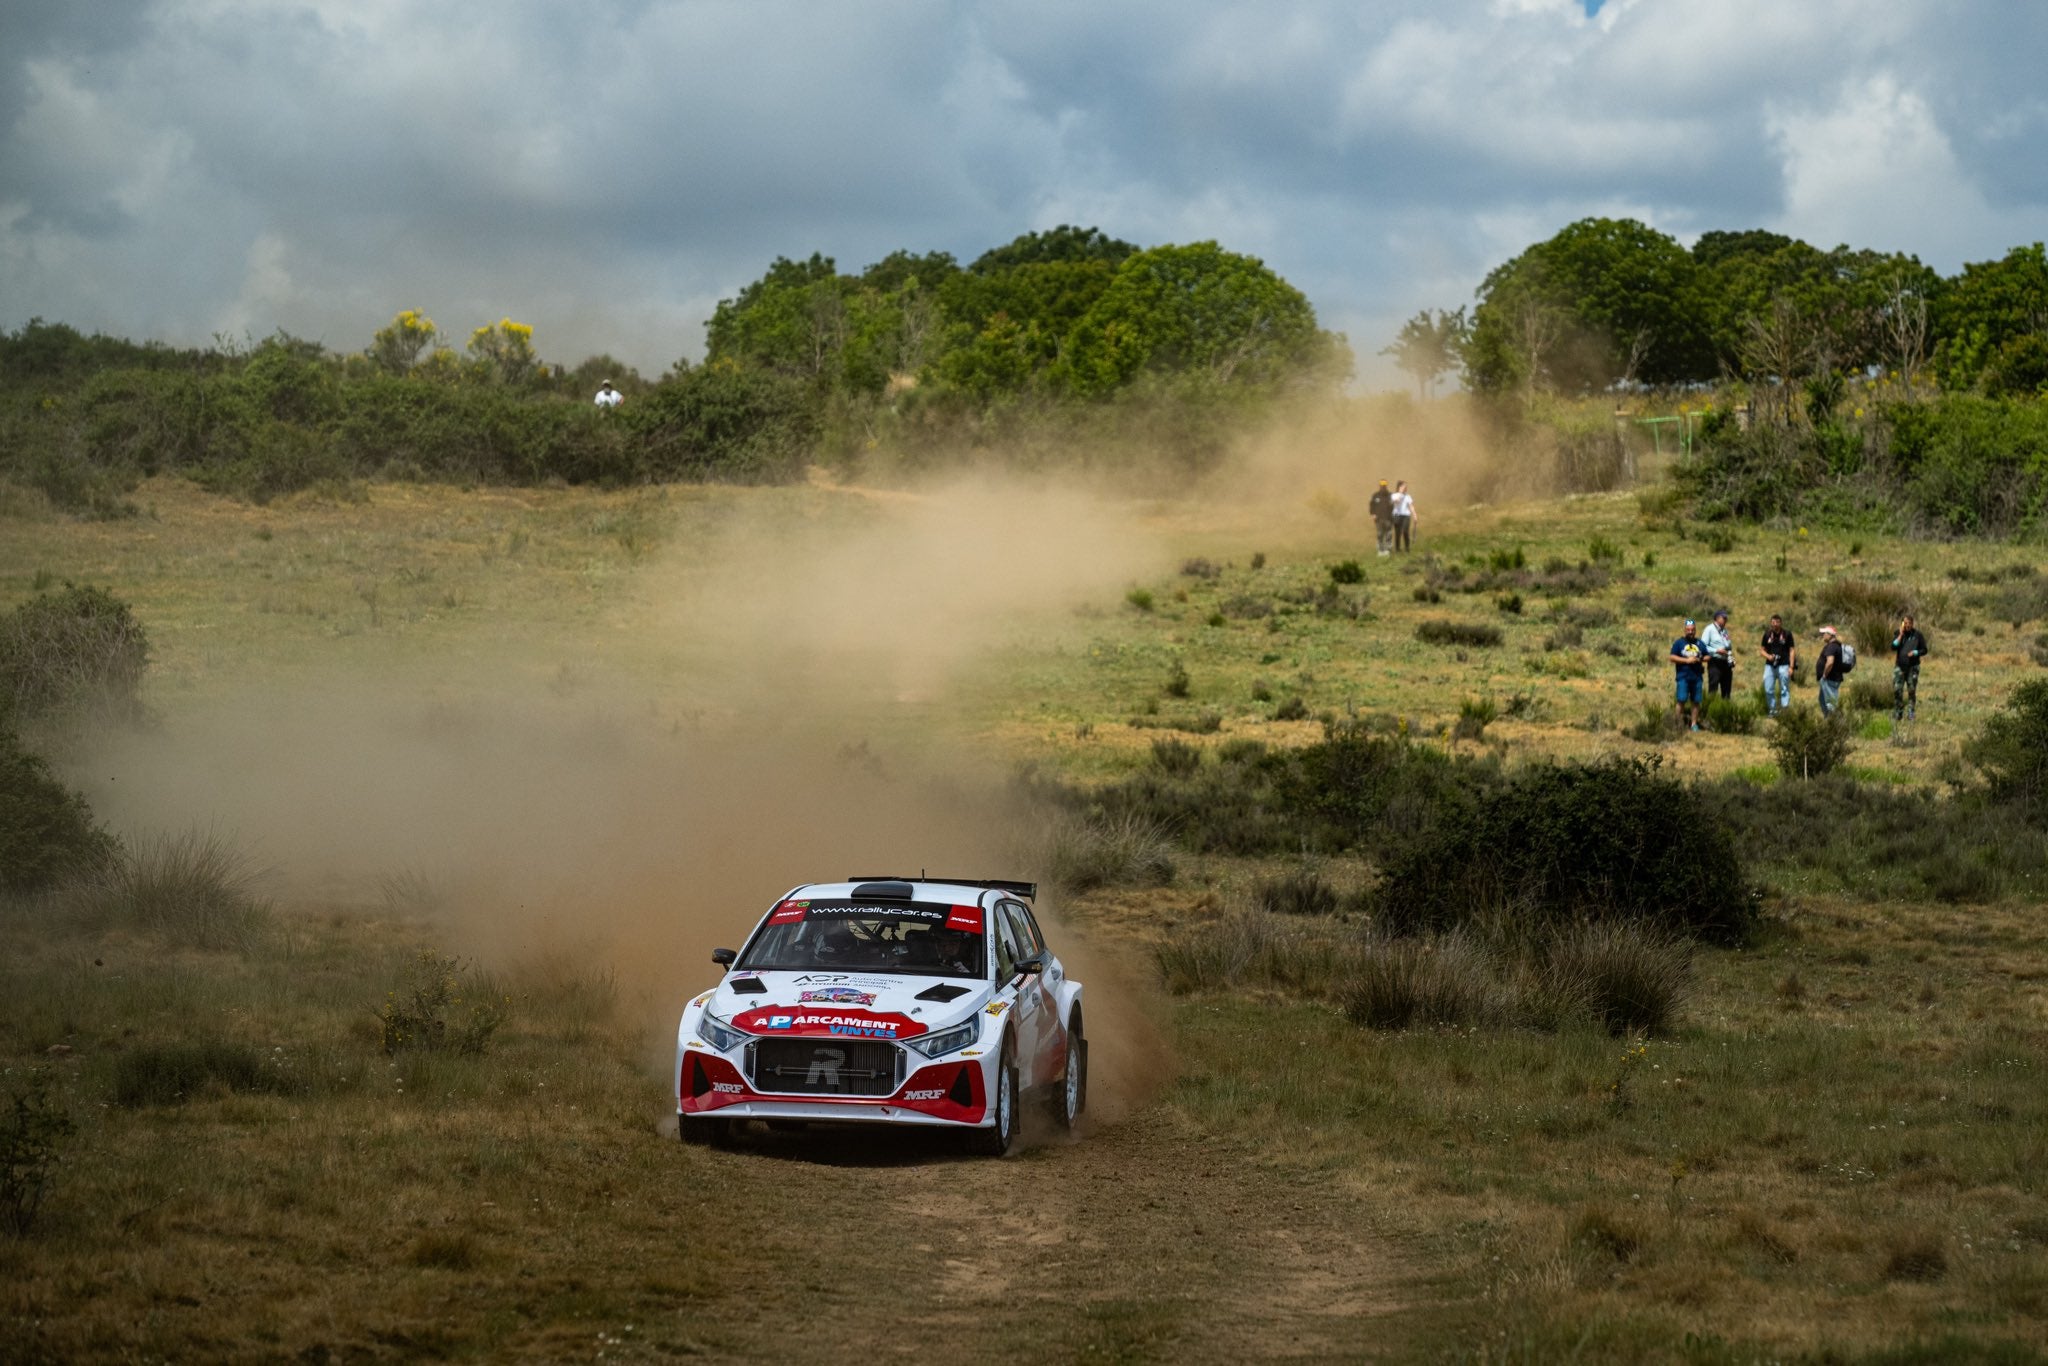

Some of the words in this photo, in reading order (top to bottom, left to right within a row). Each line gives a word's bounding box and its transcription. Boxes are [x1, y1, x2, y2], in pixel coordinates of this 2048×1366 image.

[812, 907, 942, 919] www.rallycar.es
[829, 1025, 897, 1038] VINYES
[712, 1082, 744, 1094] MRF
[903, 1089, 946, 1100] MRF
